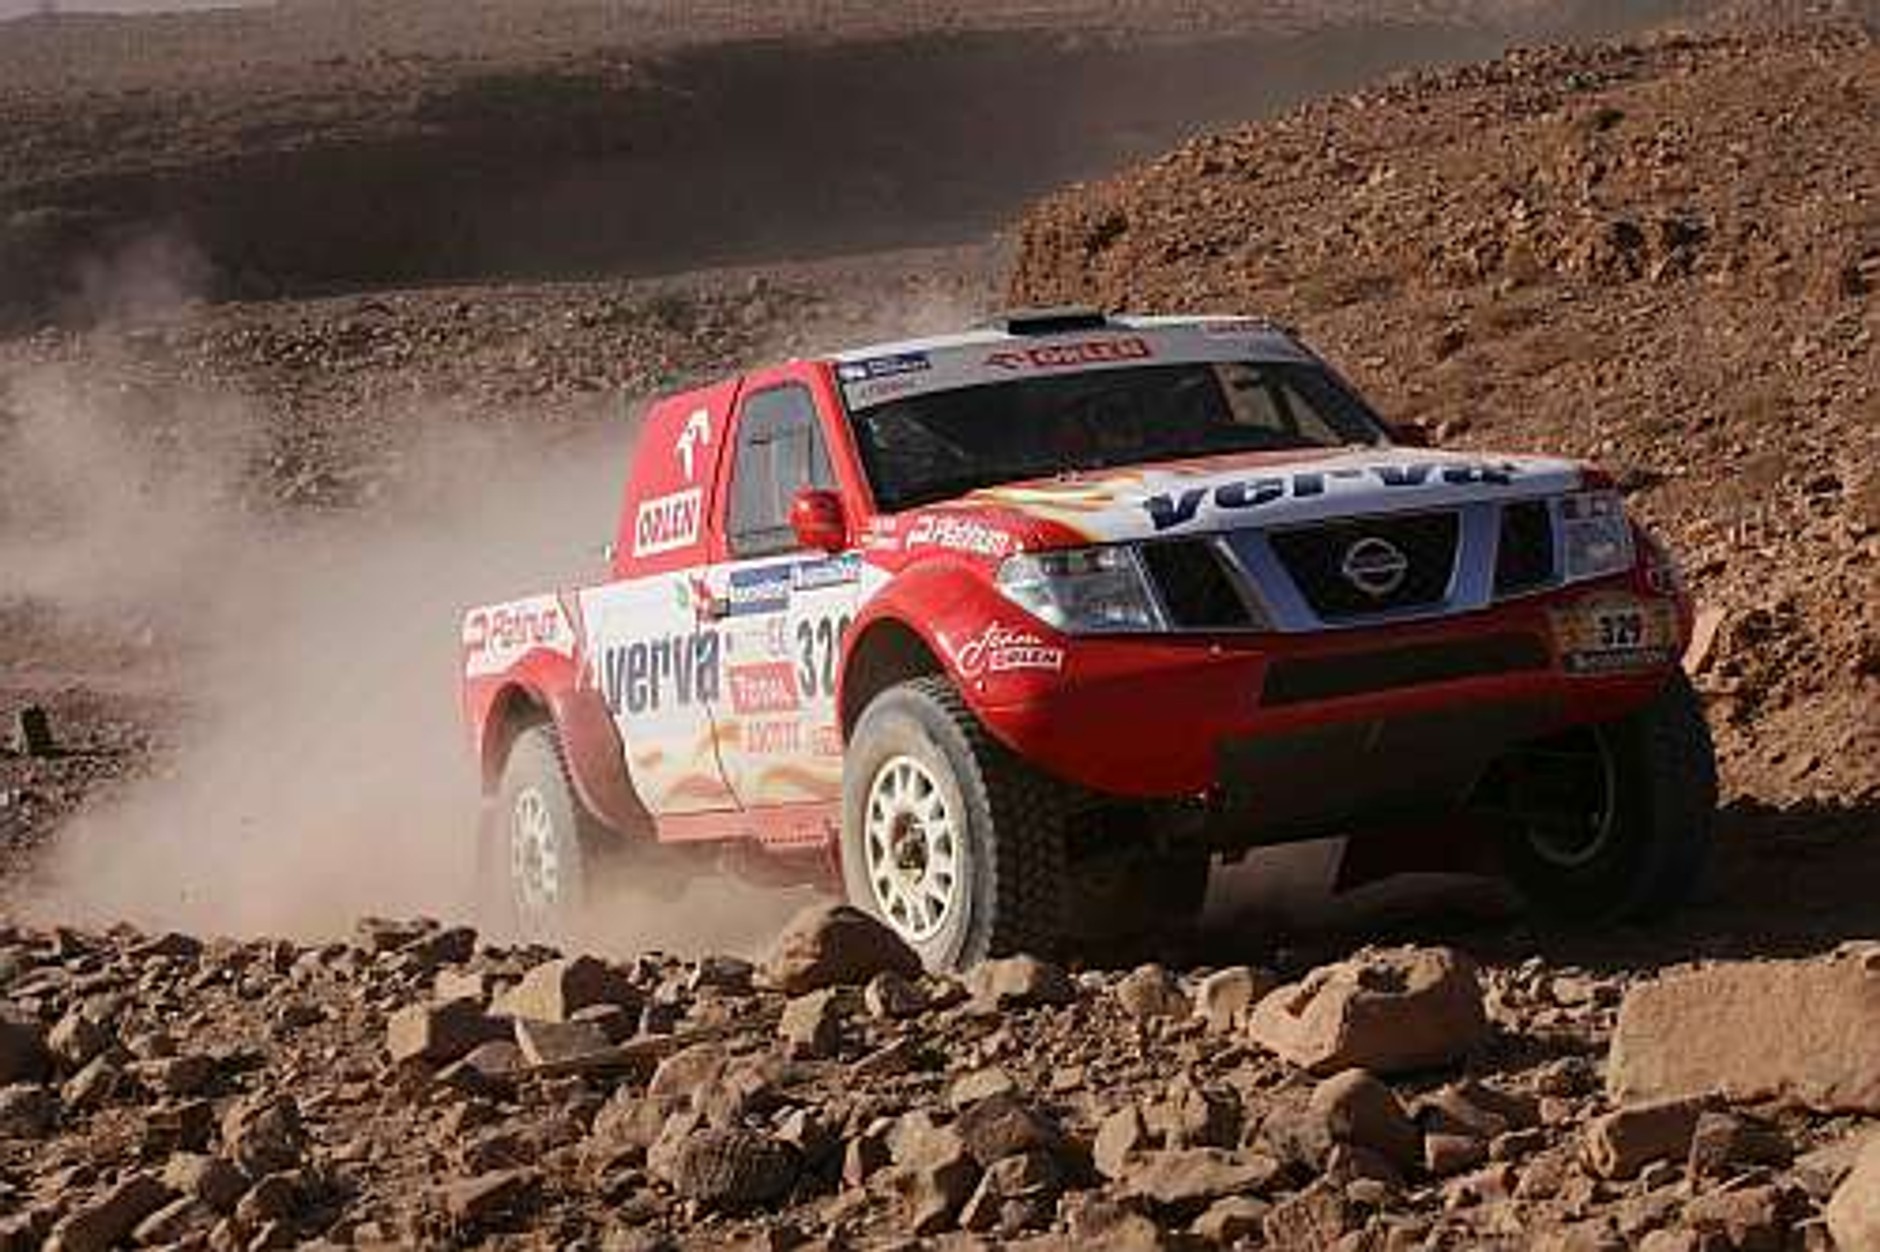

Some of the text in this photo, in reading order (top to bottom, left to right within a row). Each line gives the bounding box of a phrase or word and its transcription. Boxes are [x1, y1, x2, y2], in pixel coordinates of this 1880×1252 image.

[1034, 338, 1147, 365] ORLEN
[639, 496, 698, 547] ORLEN
[1600, 614, 1640, 643] 329
[606, 629, 720, 715] verva
[992, 651, 1059, 670] ORLEN
